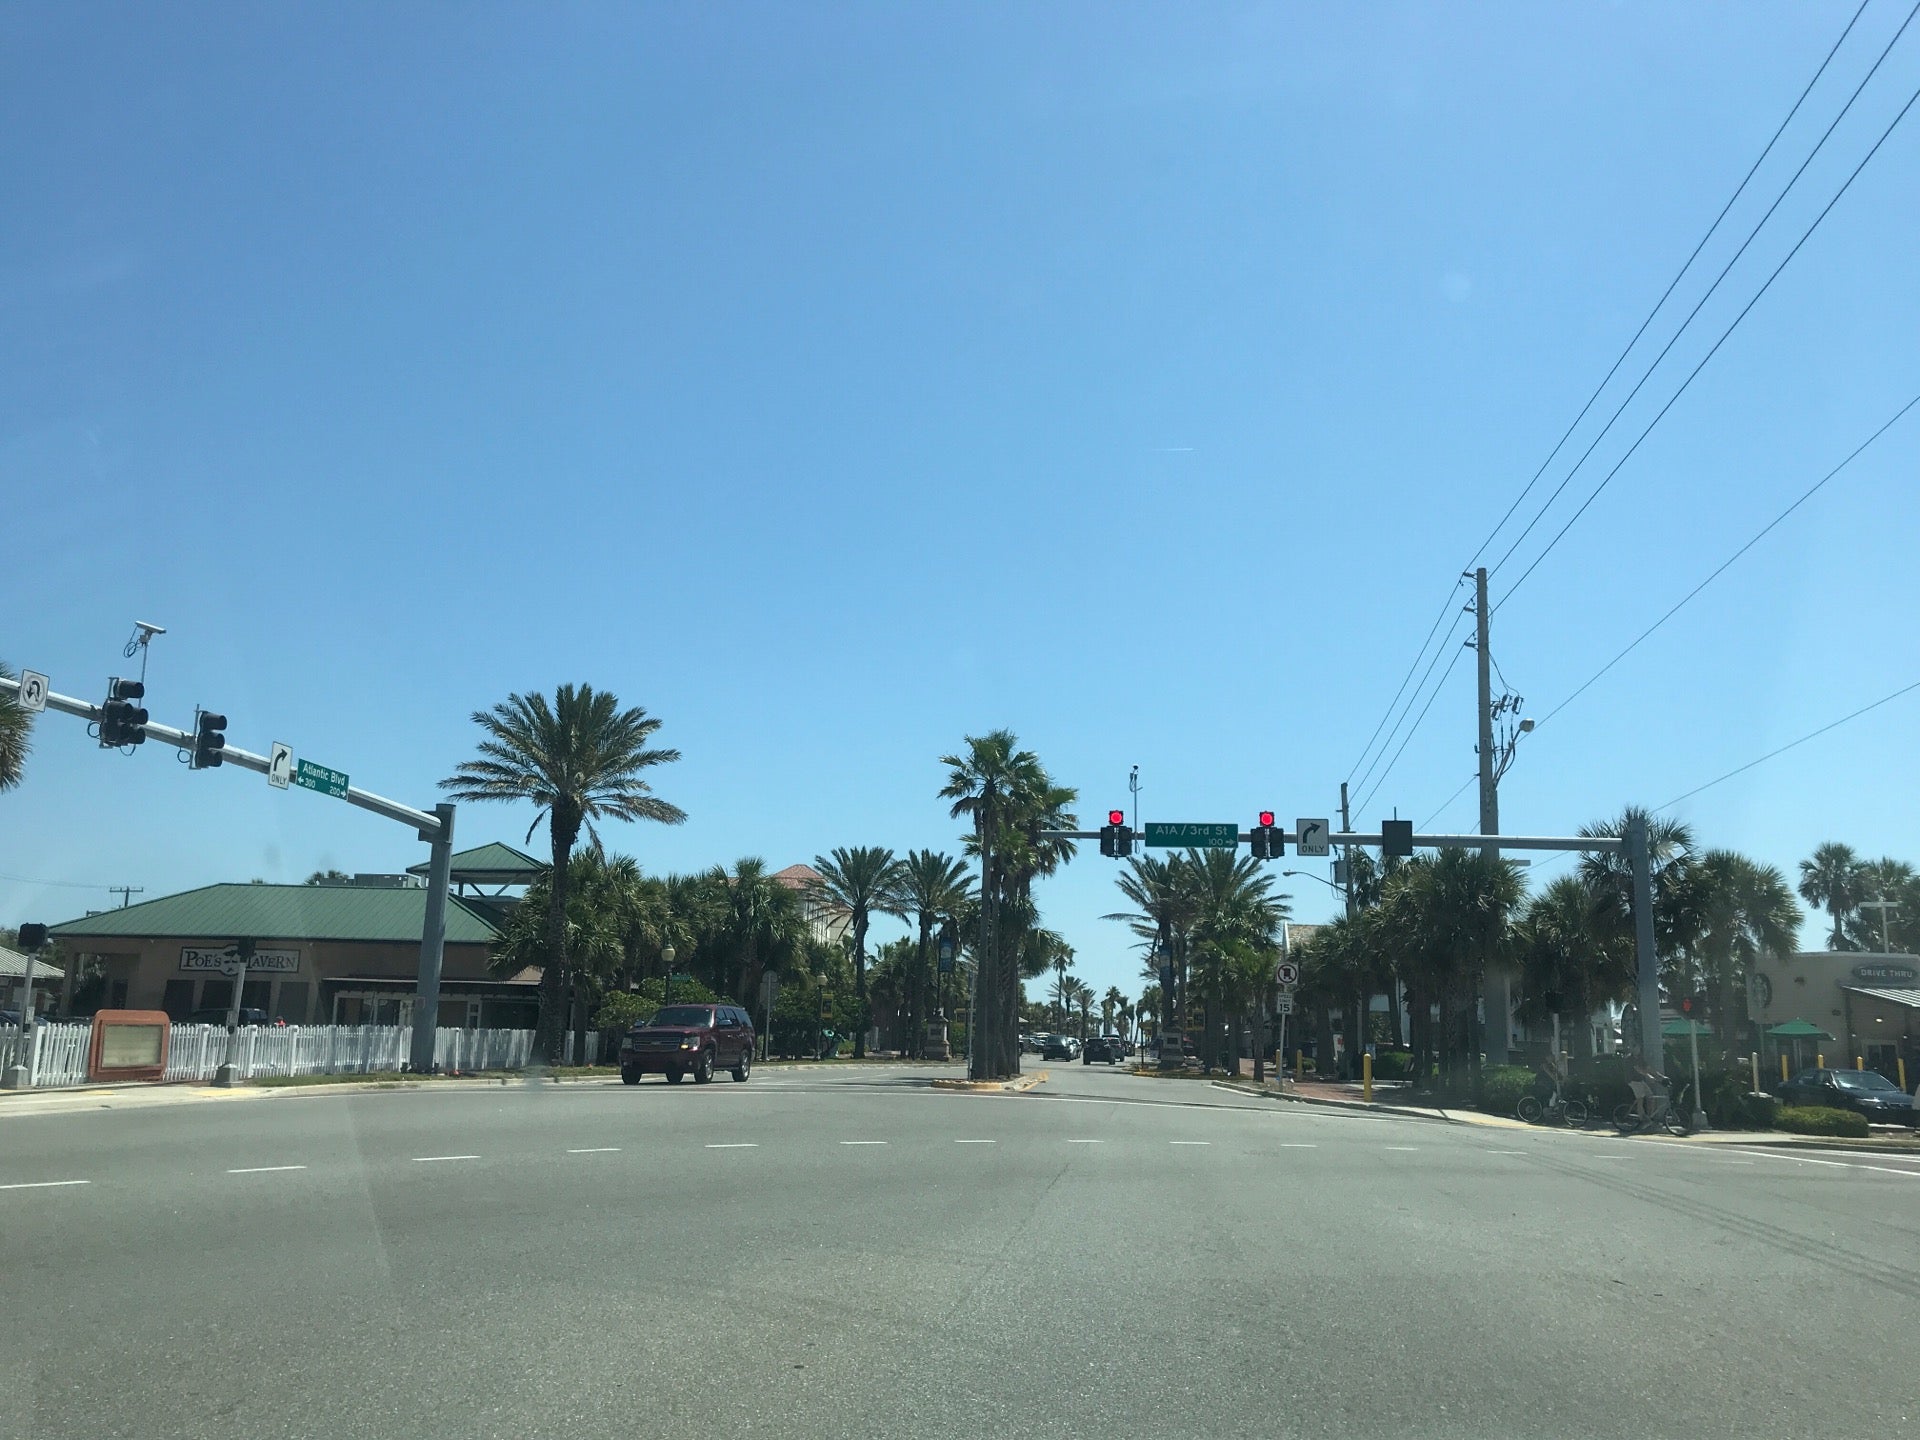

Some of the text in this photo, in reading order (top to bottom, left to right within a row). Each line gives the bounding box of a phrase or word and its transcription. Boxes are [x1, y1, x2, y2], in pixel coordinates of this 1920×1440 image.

[271, 773, 287, 785] ONLY
[302, 763, 346, 786] Atlantic Blvd
[1155, 825, 1180, 835] A1A
[1189, 825, 1210, 836] 3rd
[1215, 825, 1228, 836] St
[1208, 838, 1223, 846] 100
[1301, 845, 1325, 853] ONLY
[1860, 969, 1913, 978] DRIVE THRU
[1279, 1003, 1290, 1012] 15
